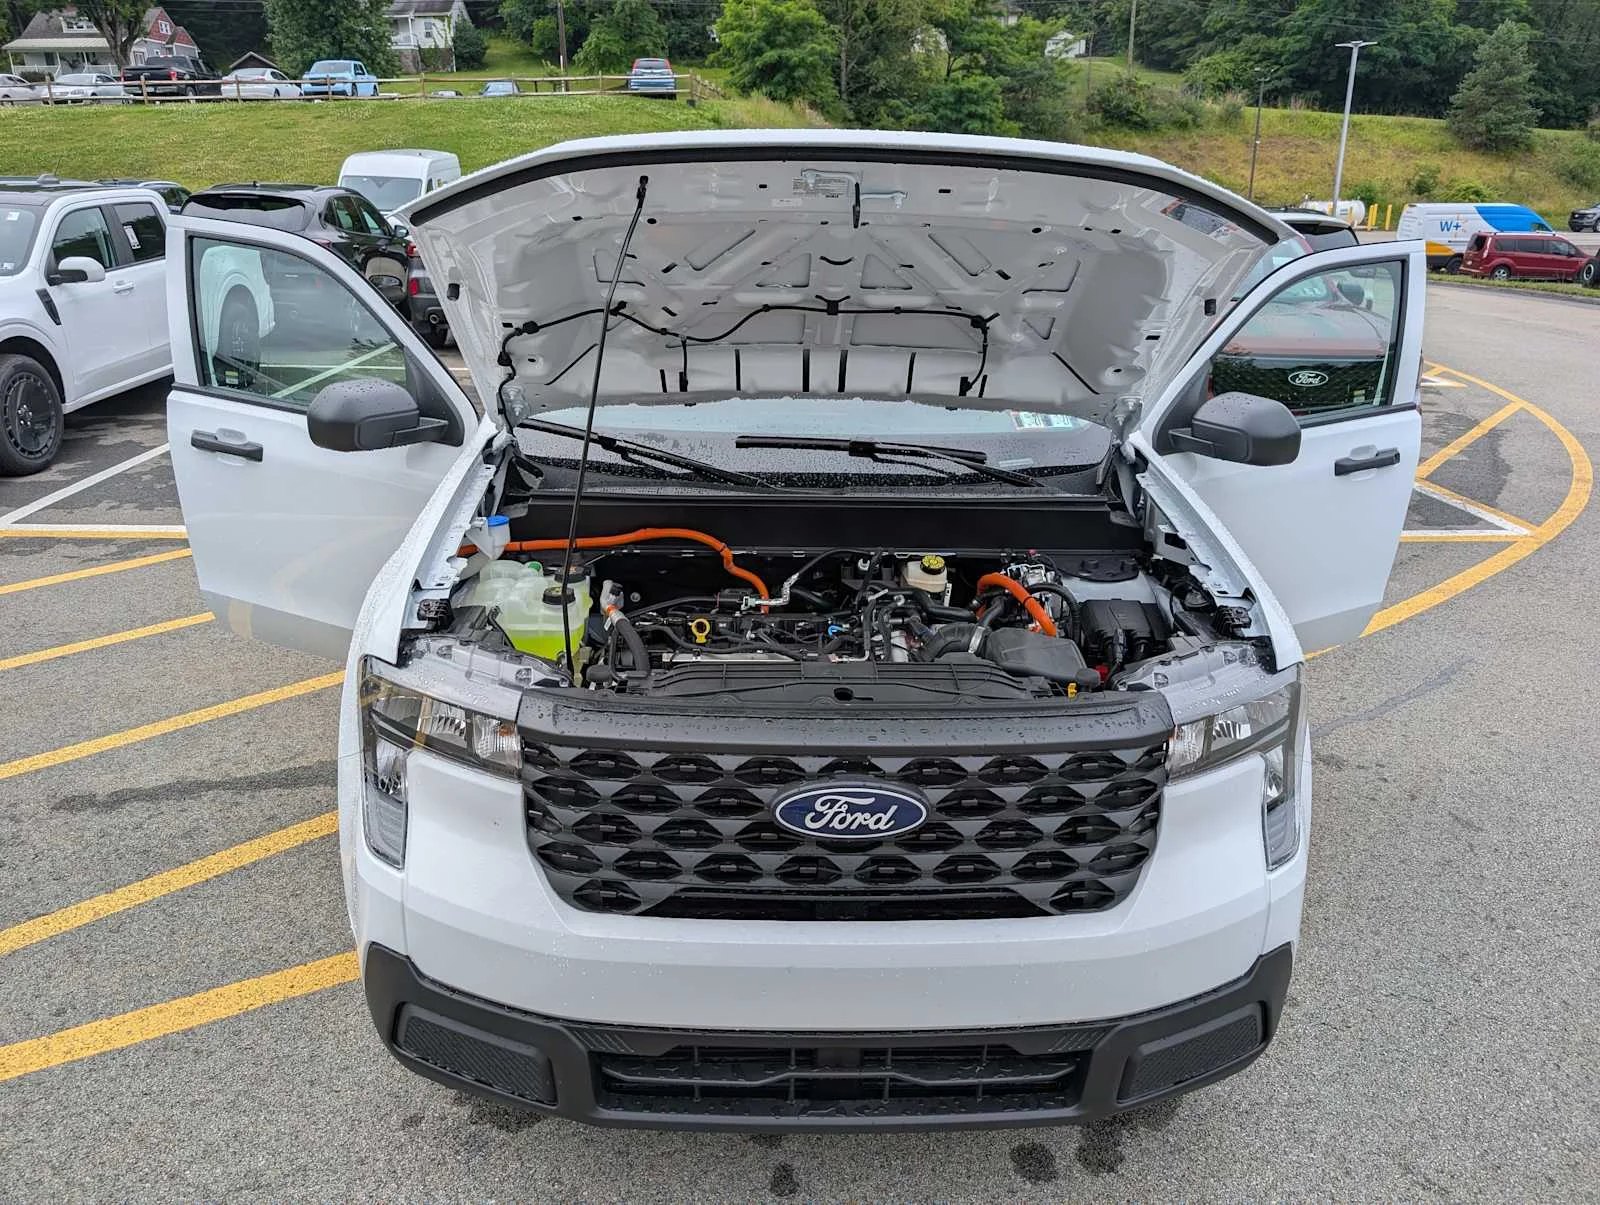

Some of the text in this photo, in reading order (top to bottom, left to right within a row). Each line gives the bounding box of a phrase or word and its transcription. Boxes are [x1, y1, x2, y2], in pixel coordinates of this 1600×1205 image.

[1440, 221, 1461, 232] W+
[1295, 373, 1322, 384] Ford
[804, 795, 898, 830] Ford
